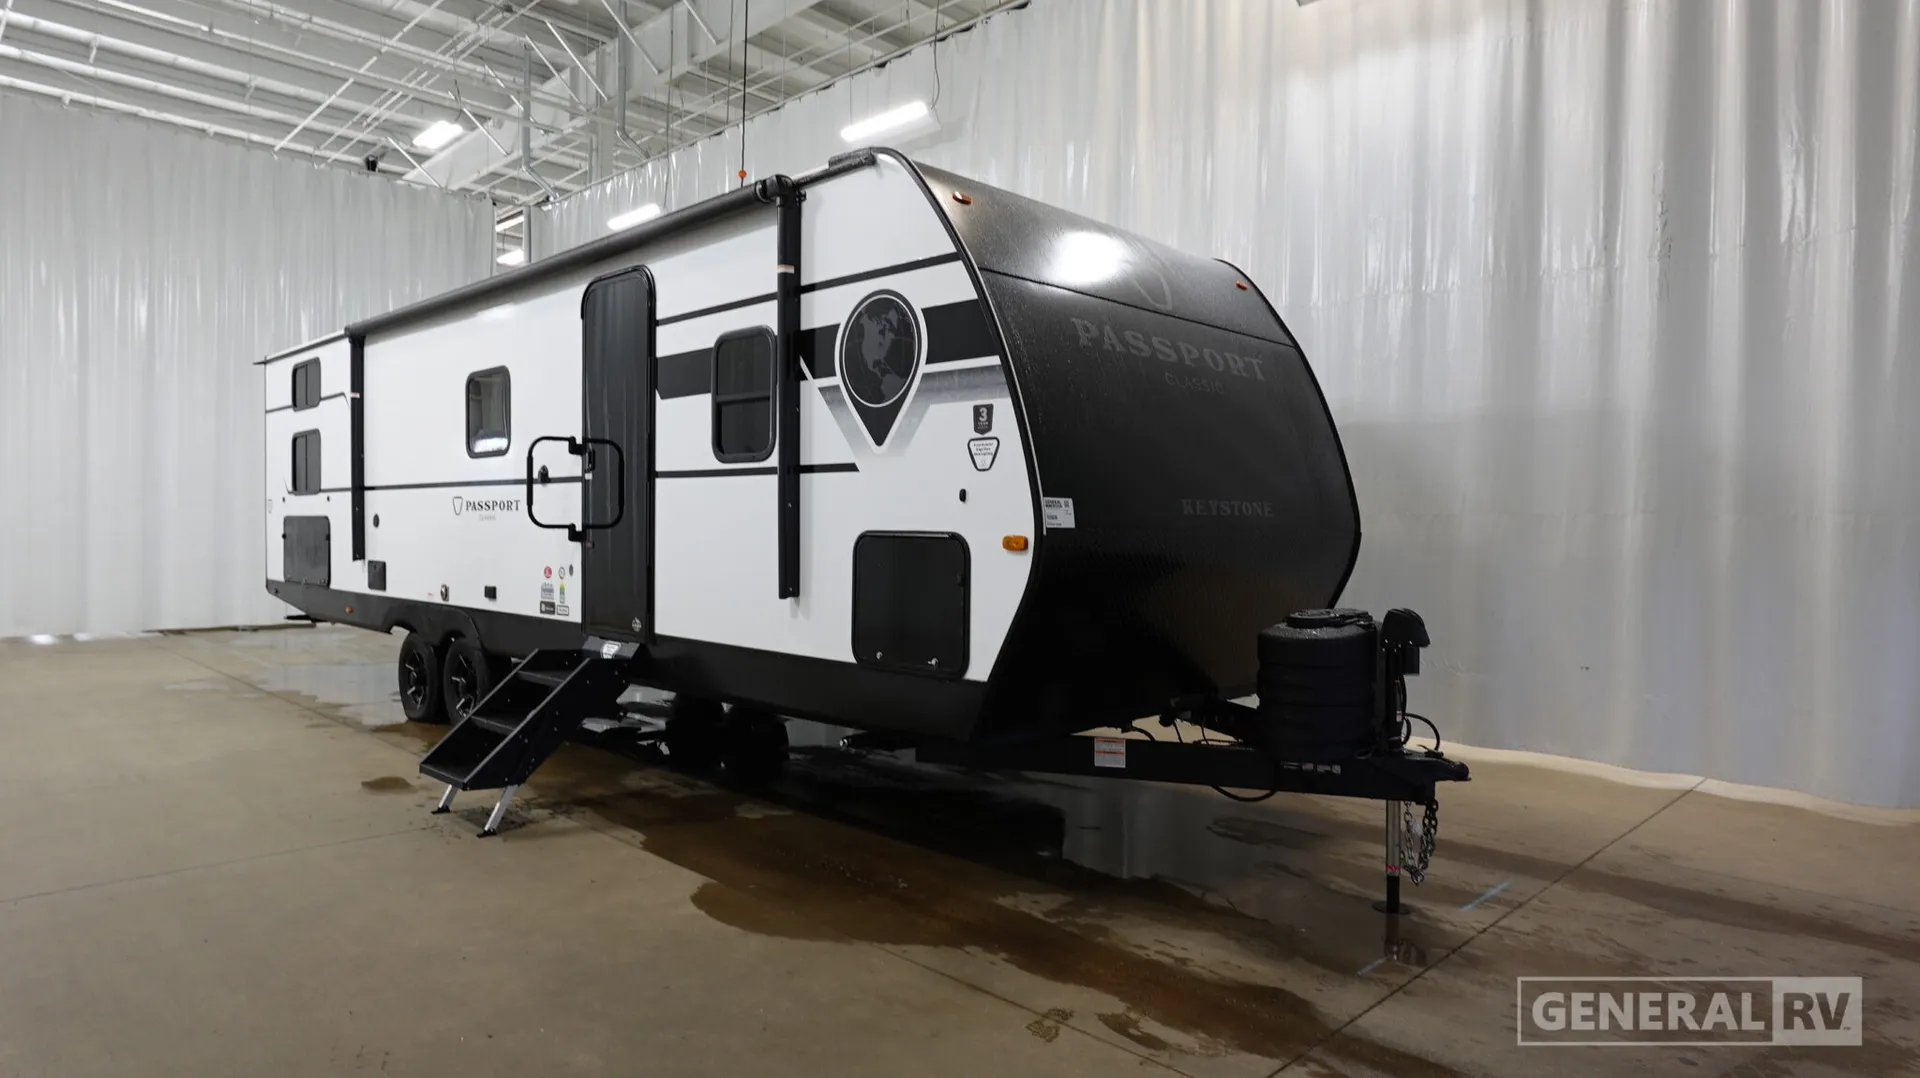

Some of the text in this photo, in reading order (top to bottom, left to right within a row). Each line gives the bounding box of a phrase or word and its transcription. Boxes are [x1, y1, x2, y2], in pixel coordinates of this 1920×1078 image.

[1071, 317, 1265, 381] PASSPORT
[1164, 371, 1225, 394] CLASSIC
[979, 407, 988, 422] 3
[465, 499, 521, 512] PASSPORT
[1181, 499, 1274, 517] KEYSTONE
